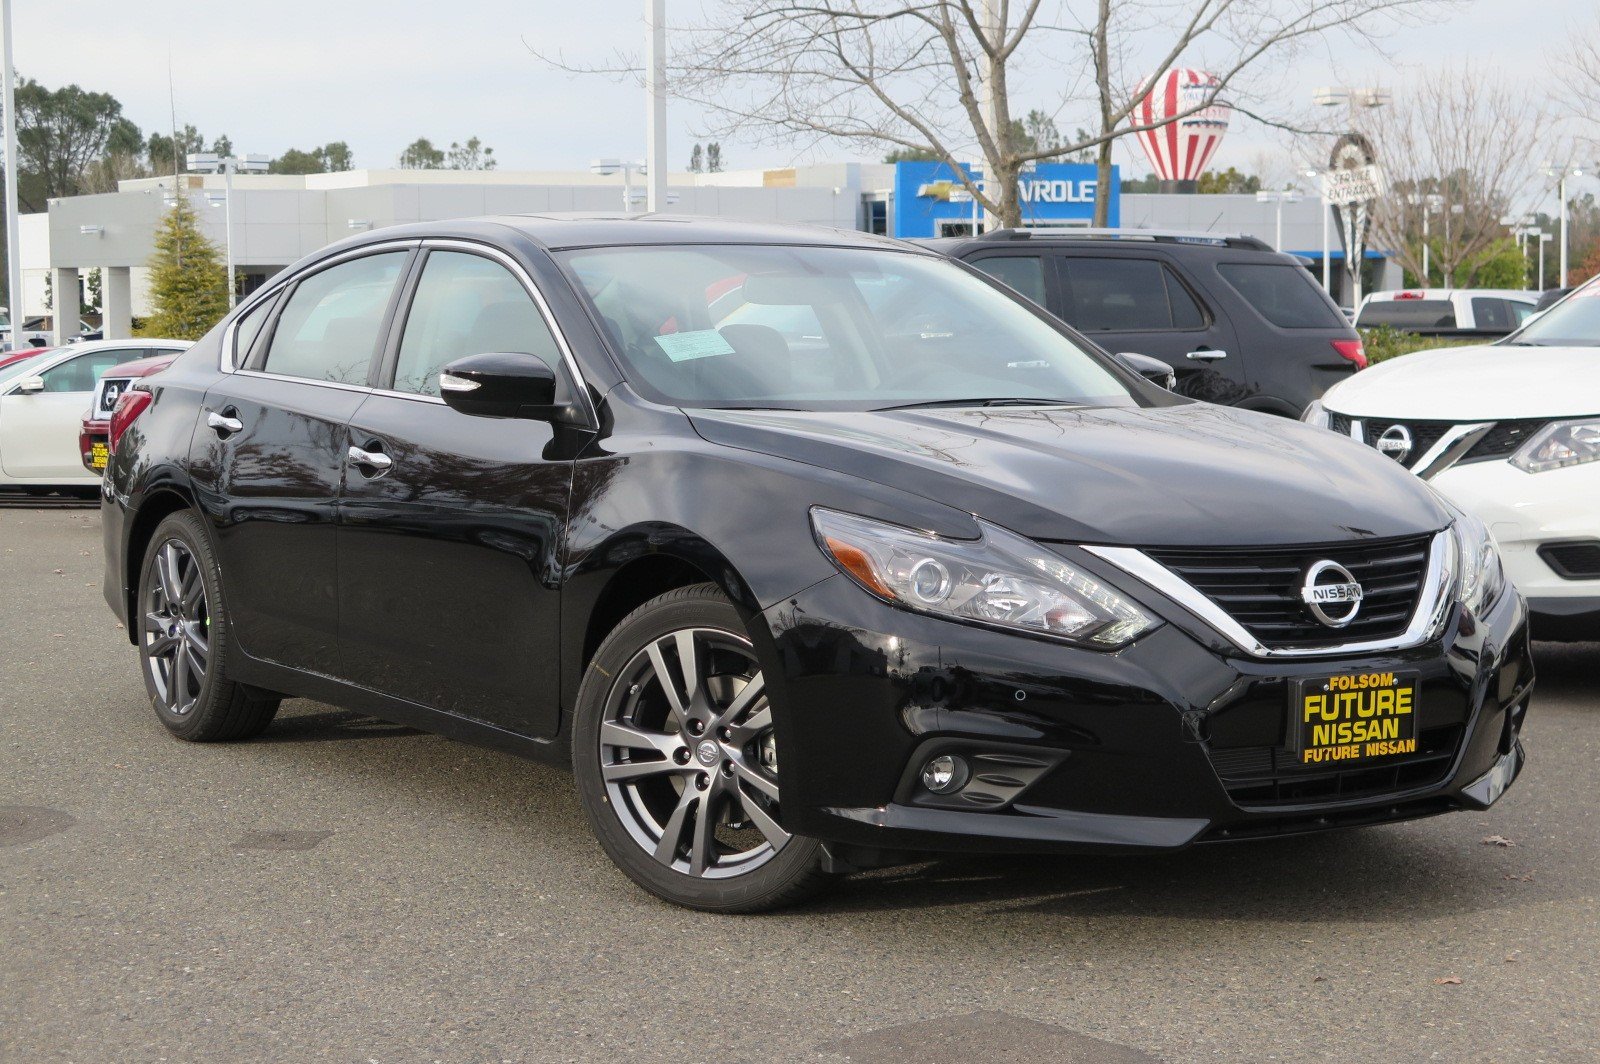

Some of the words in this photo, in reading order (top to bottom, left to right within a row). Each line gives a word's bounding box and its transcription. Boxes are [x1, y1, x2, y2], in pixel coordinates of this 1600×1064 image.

[972, 179, 1099, 203] VROLE
[1313, 587, 1362, 600] NISSAN
[1329, 672, 1394, 691] FOLSOM
[1304, 687, 1413, 723] FUTURE
[1312, 718, 1399, 746] NISSAN
[1304, 744, 1360, 763] FUTURE
[1366, 739, 1416, 757] NISSAN
